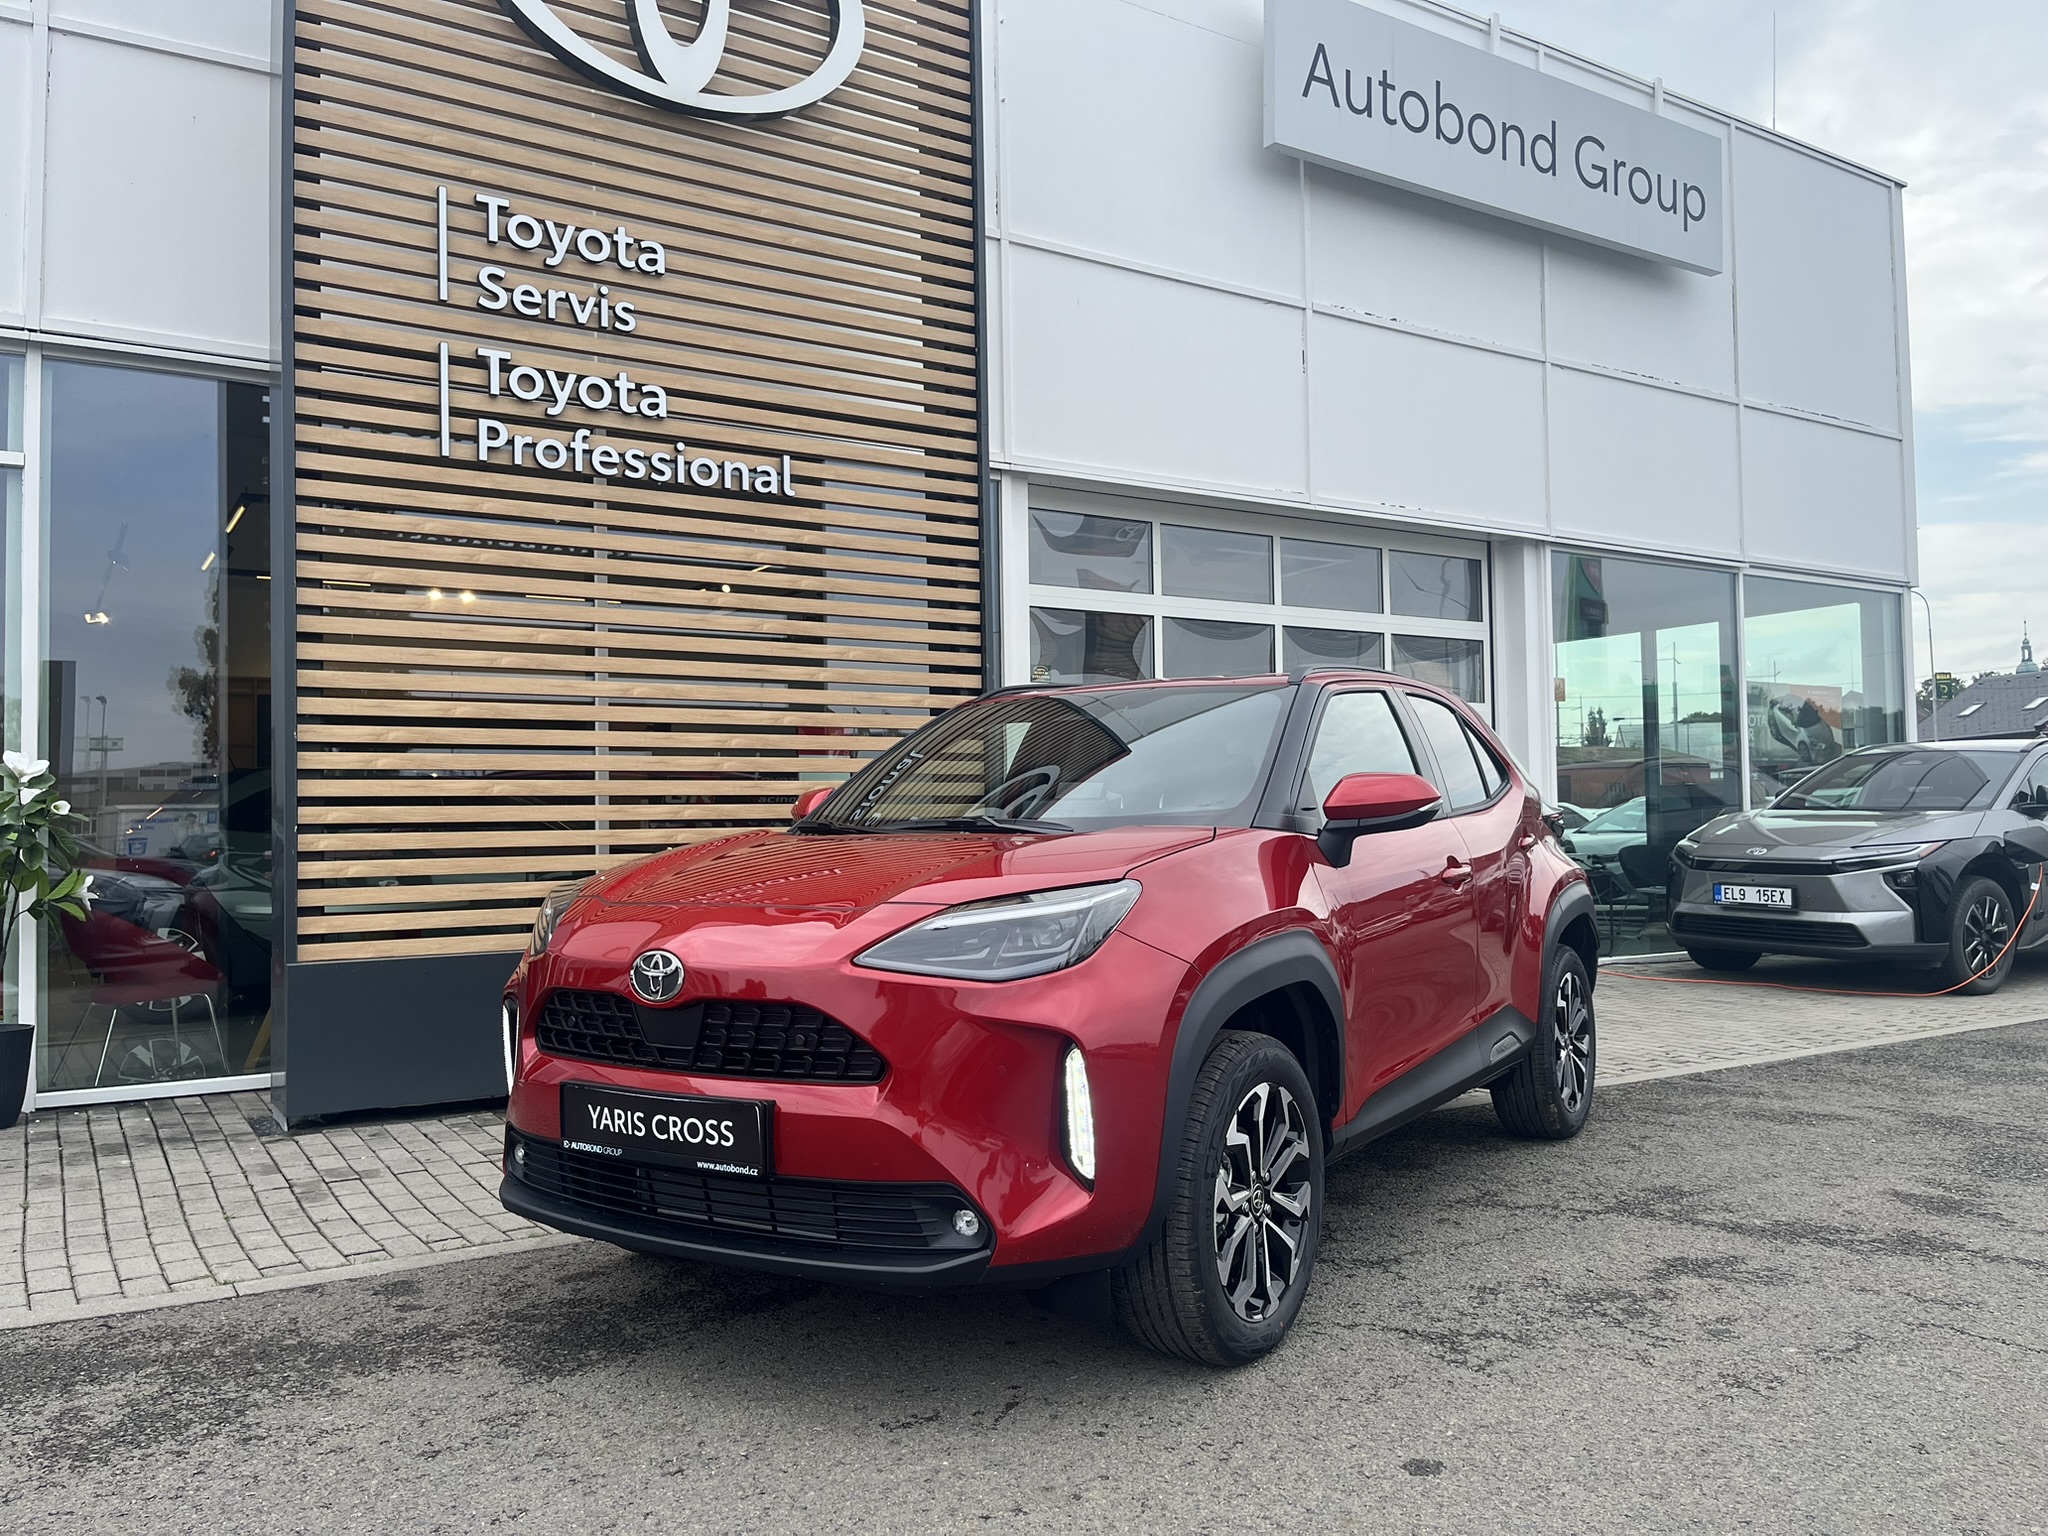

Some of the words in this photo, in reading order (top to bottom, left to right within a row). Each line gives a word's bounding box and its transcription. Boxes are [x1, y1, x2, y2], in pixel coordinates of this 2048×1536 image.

[1302, 42, 1557, 177] Autobond
[1574, 135, 1707, 232] Group
[474, 193, 667, 276] Toyota
[476, 266, 637, 332] Servis
[476, 347, 668, 420] Toyota
[476, 418, 796, 497] Professional
[1724, 887, 1746, 901] EL9
[1755, 889, 1786, 903] 15EX
[571, 1141, 603, 1154] AUTOBOND
[603, 1146, 623, 1156] GROUP
[588, 1104, 646, 1137] YARIS
[651, 1114, 734, 1147] CROSS
[696, 1161, 759, 1176] www.autobond.cz
